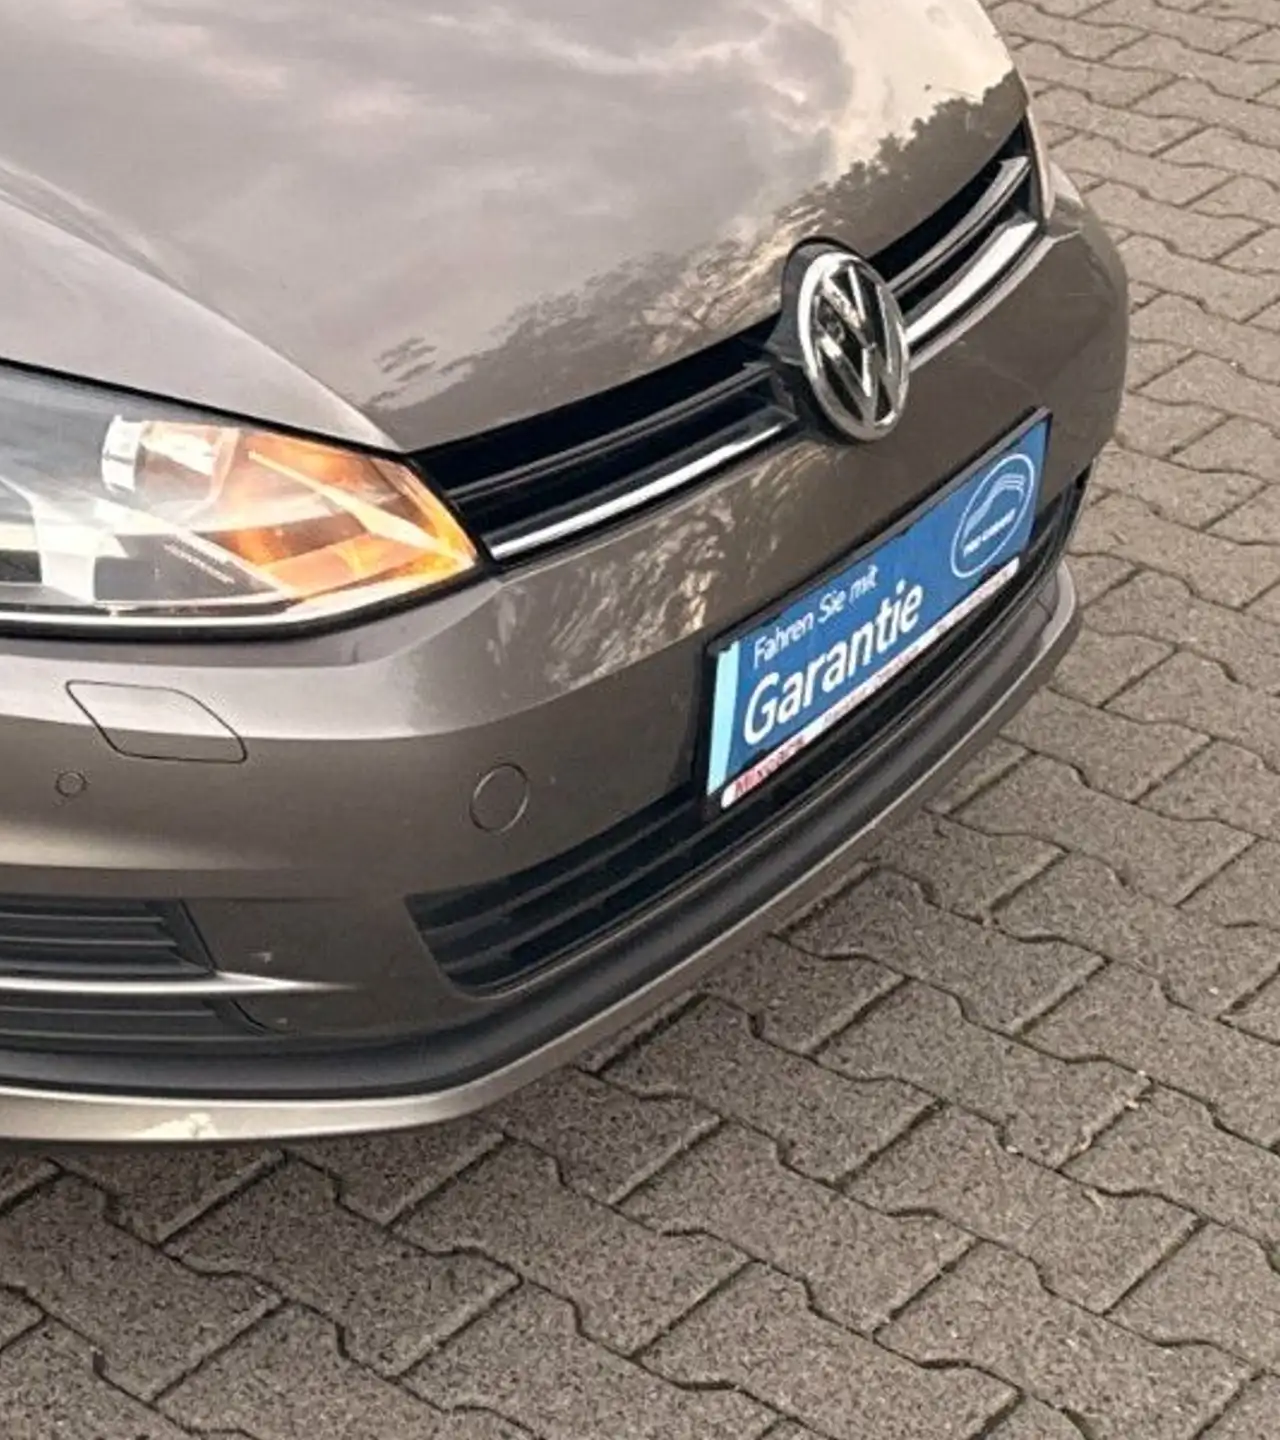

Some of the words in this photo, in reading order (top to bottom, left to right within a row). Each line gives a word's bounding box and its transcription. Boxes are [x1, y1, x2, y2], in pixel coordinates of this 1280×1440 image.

[743, 578, 924, 746] Garantie
[753, 611, 814, 670] Fahren
[818, 588, 847, 623] Sie
[848, 564, 879, 605] mit
